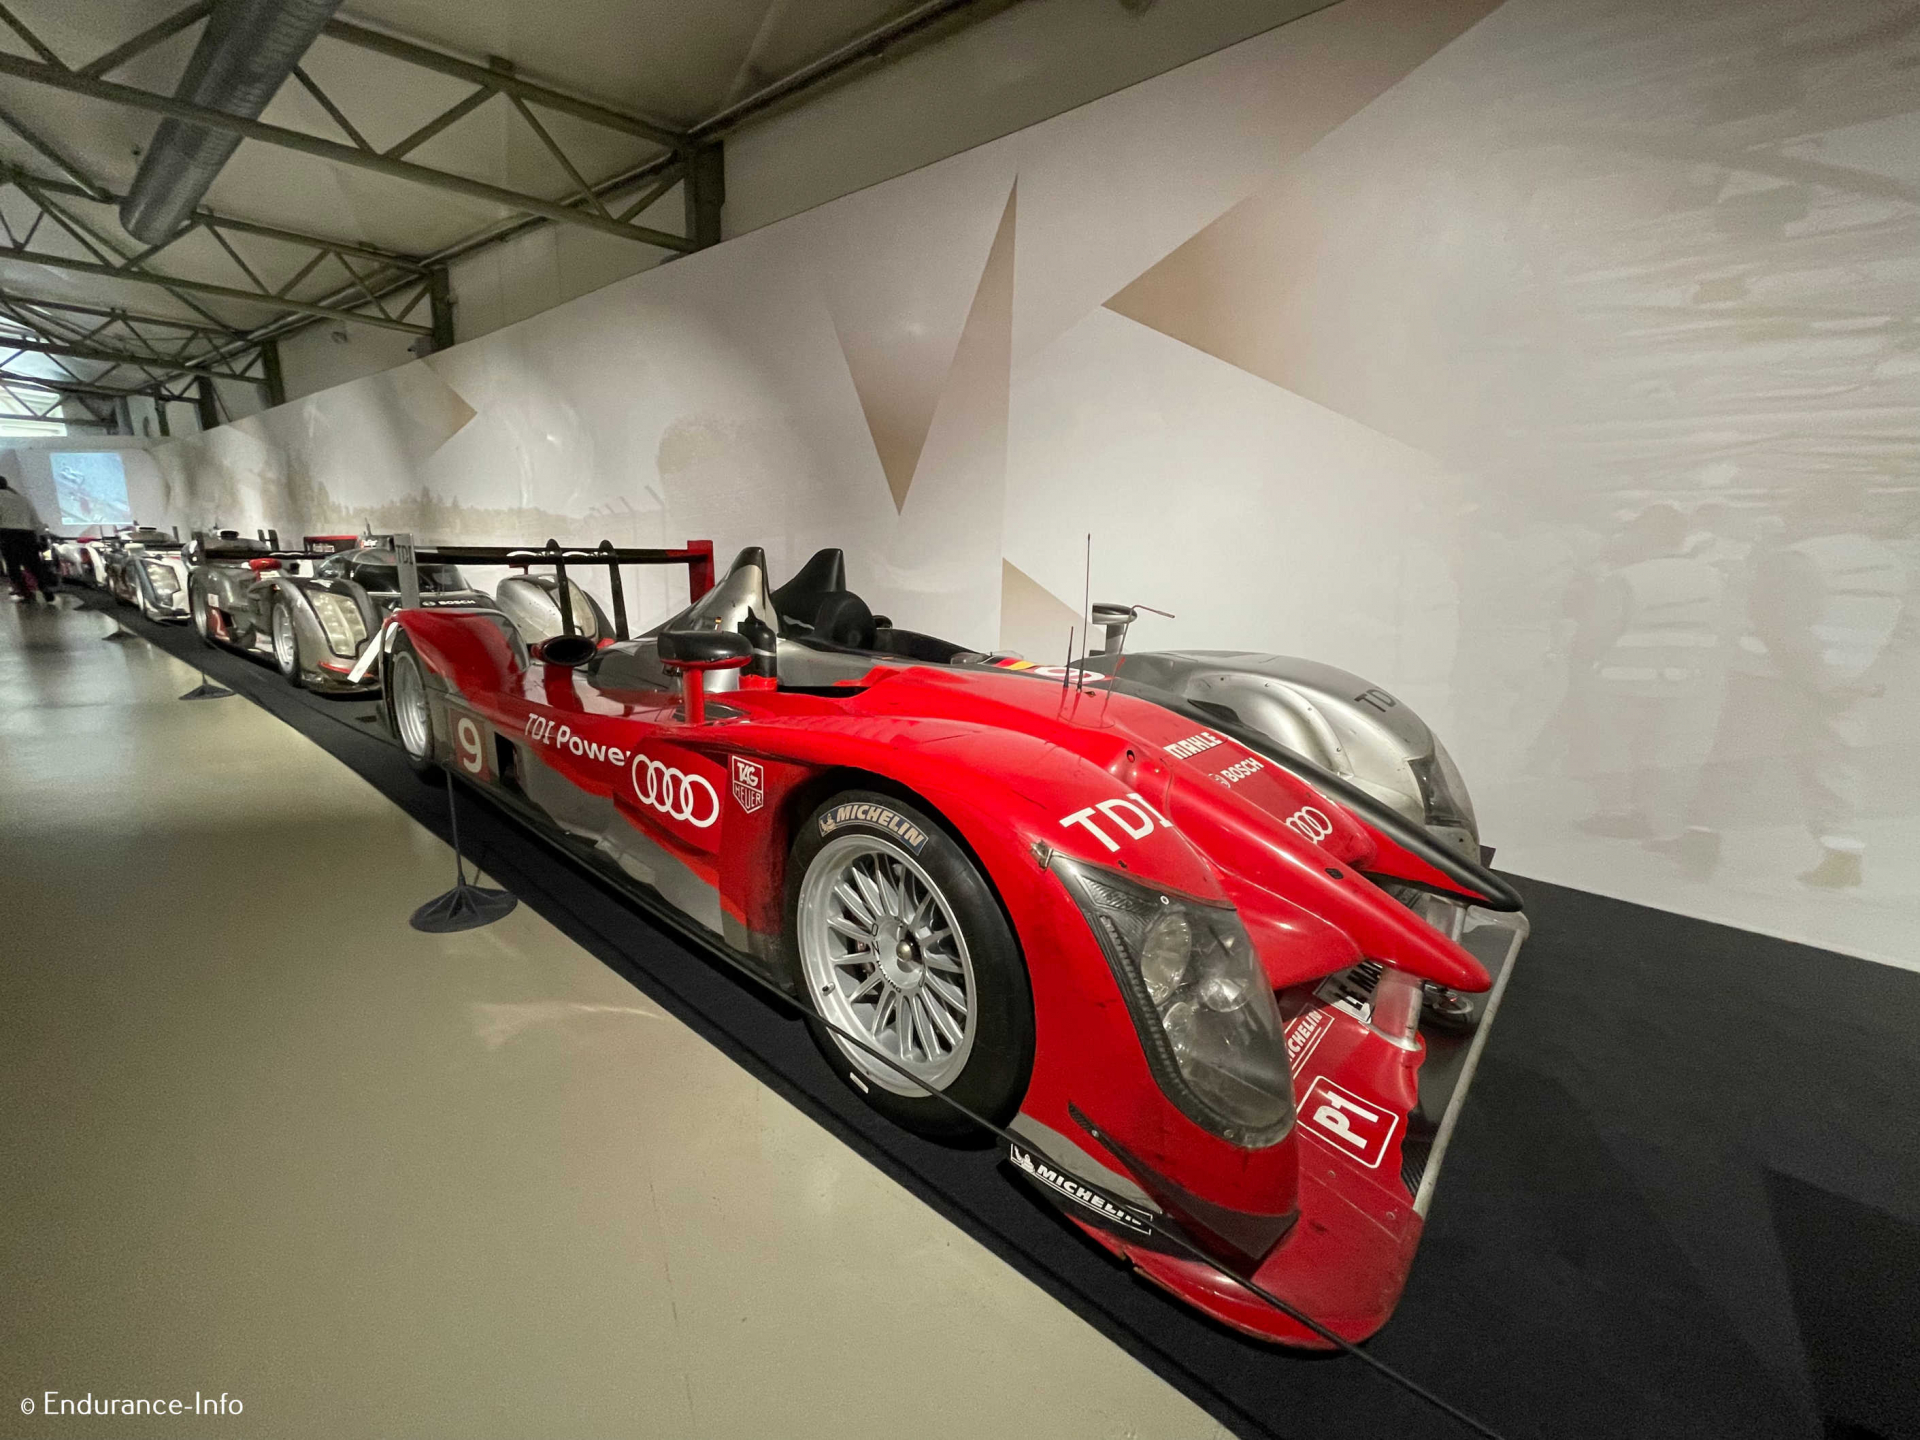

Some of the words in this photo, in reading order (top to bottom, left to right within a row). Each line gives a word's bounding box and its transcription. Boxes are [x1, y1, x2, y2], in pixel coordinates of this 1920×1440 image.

[524, 712, 556, 745] TDI
[457, 717, 483, 774] 9
[1162, 731, 1223, 761] MAHLE
[736, 761, 760, 788] TAG
[1219, 757, 1265, 783] BOSCH
[734, 781, 762, 811] HEUER
[835, 804, 926, 848] MICHELIN
[1058, 792, 1174, 854] TDI
[1312, 1090, 1380, 1150] P1
